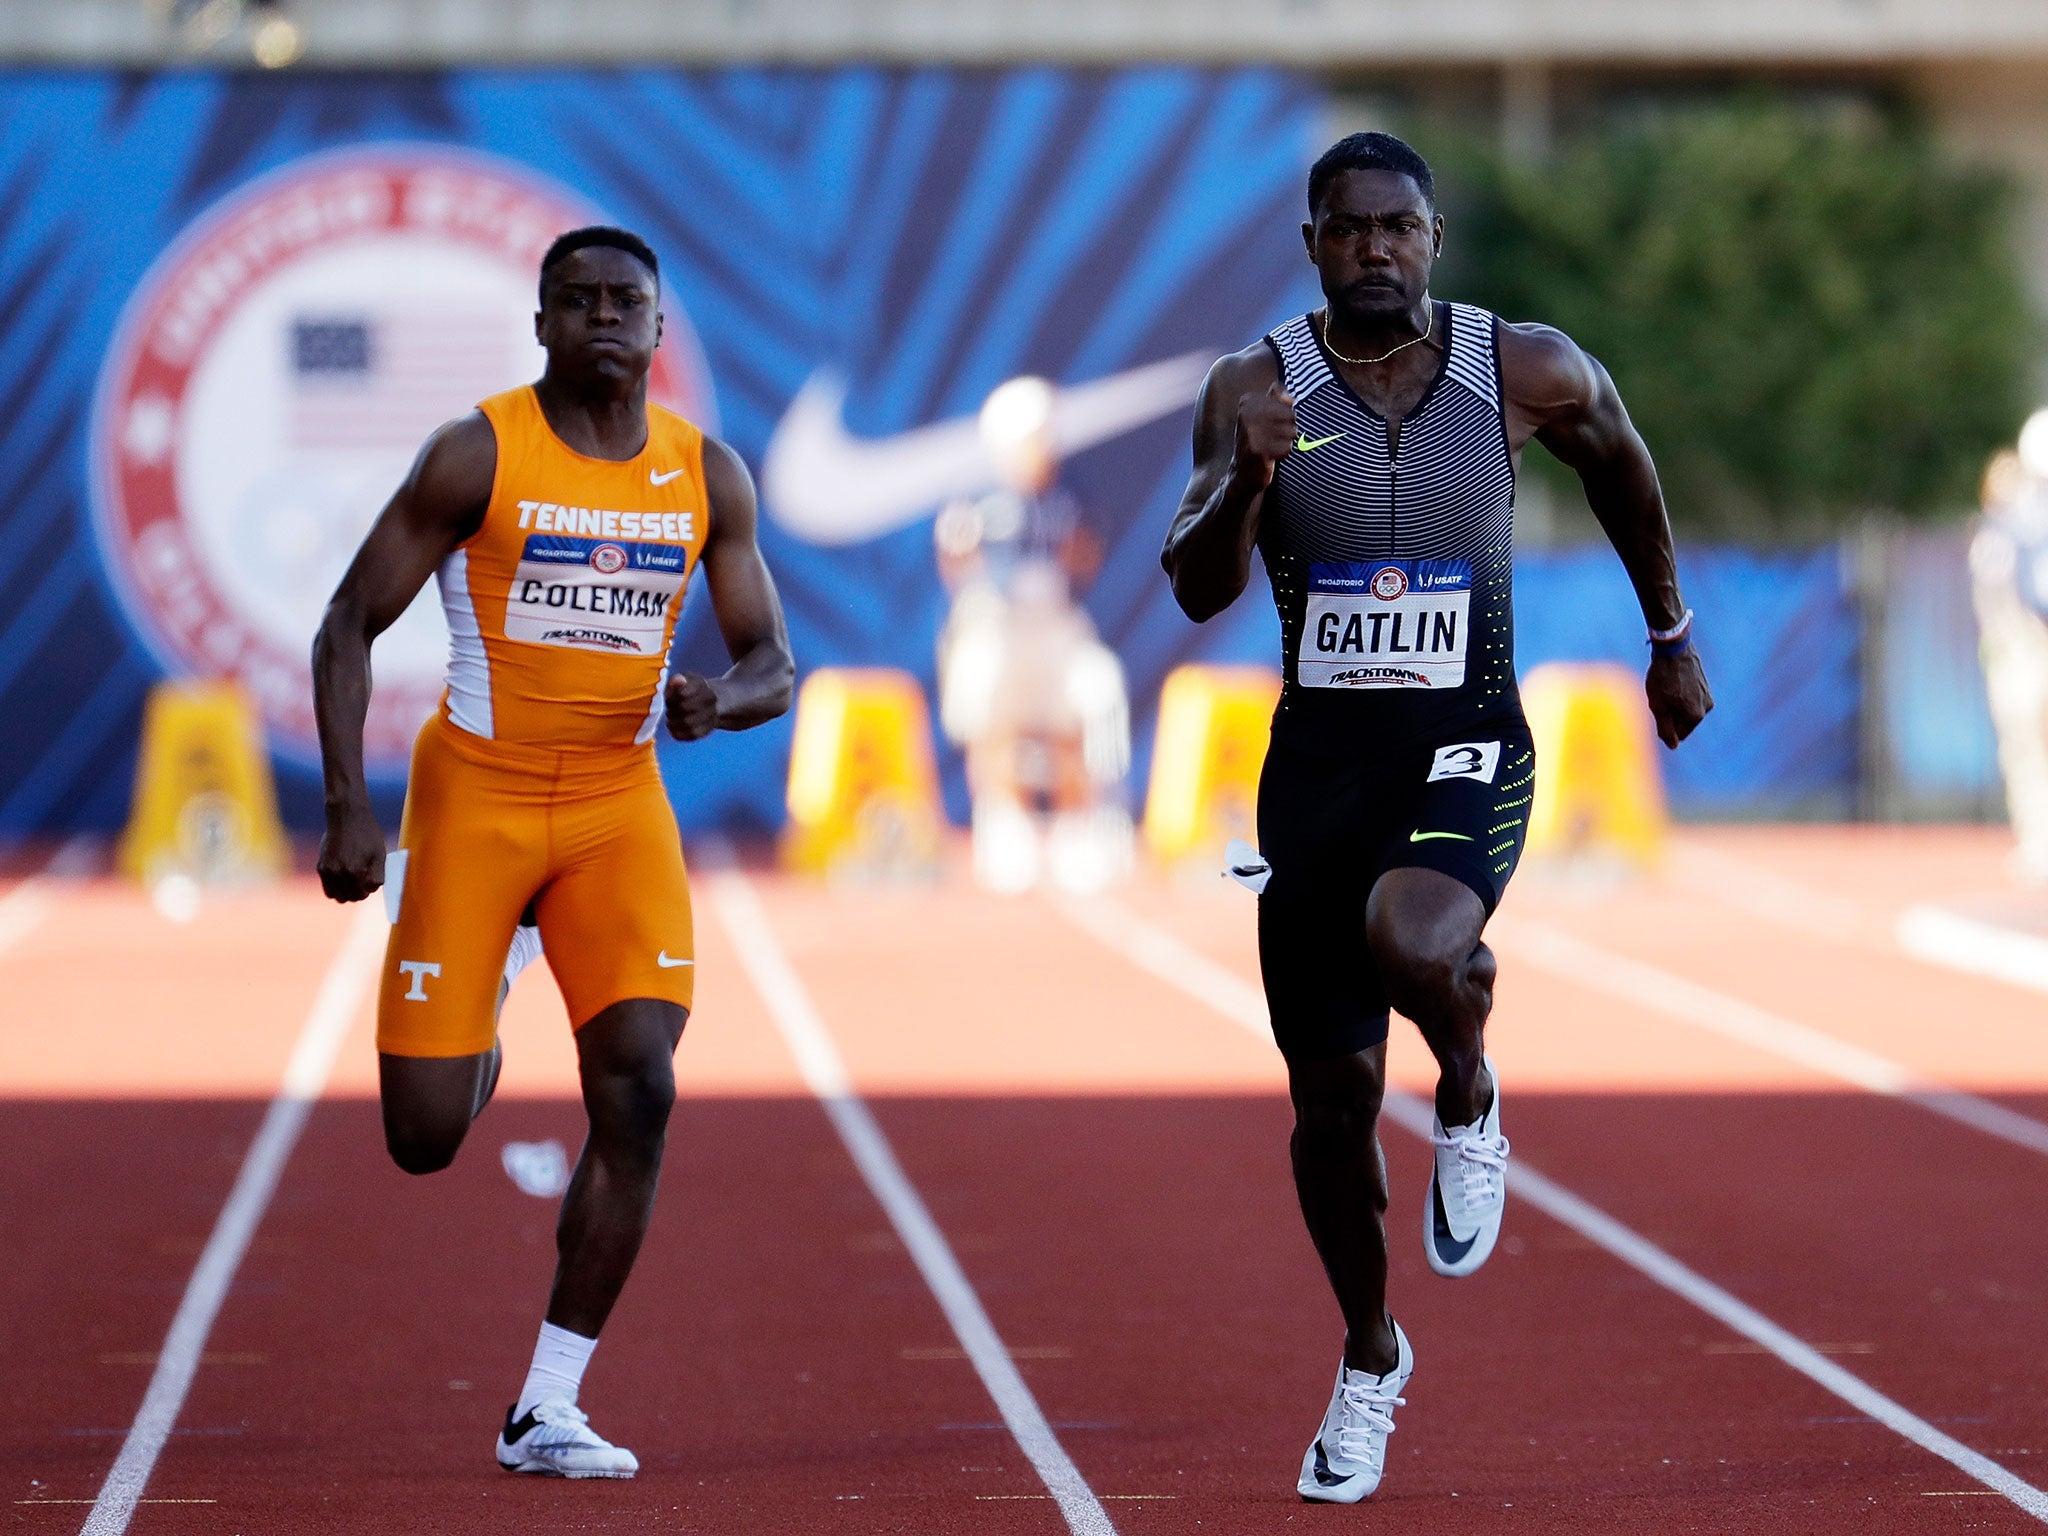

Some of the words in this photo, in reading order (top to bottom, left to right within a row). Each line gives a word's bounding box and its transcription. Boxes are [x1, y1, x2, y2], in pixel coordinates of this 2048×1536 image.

[517, 499, 694, 541] TENNESSEE
[521, 579, 670, 618] COLEMAN
[1434, 575, 1463, 585] USATF
[1316, 610, 1457, 654] GATLIN
[1438, 746, 1485, 776] 3
[399, 960, 442, 1002] T
